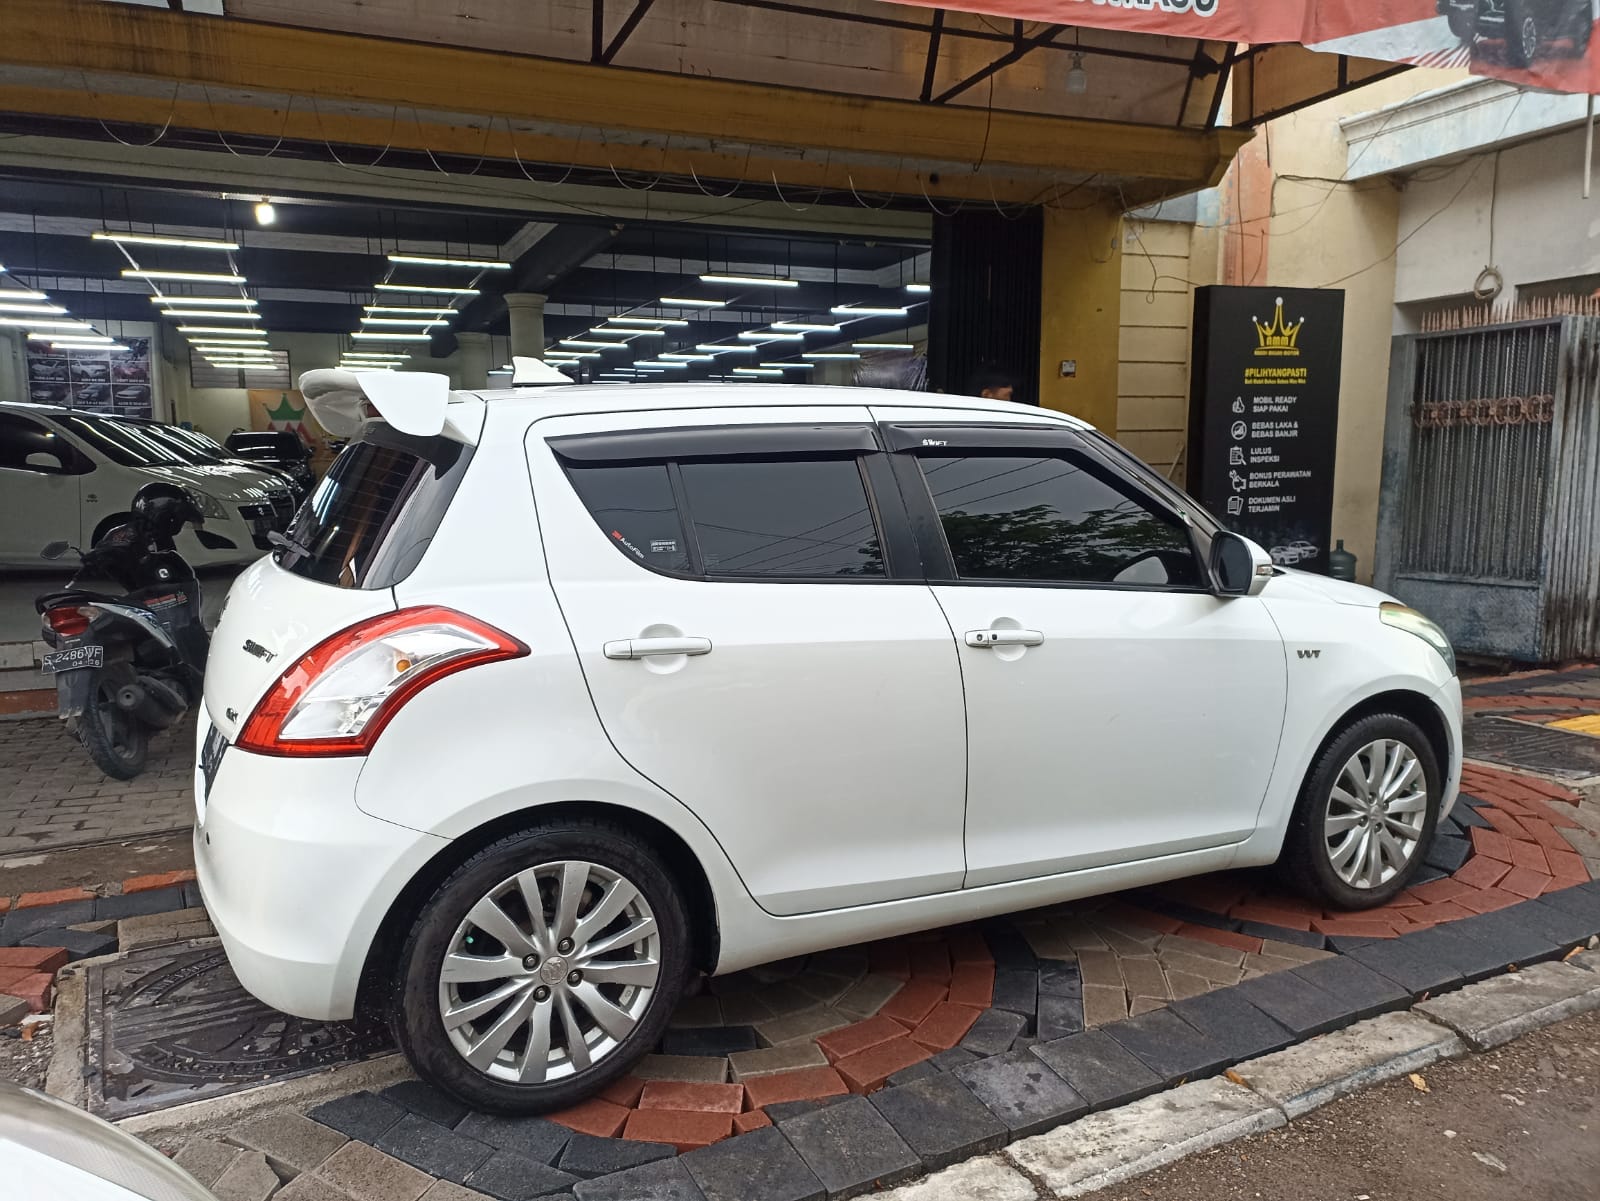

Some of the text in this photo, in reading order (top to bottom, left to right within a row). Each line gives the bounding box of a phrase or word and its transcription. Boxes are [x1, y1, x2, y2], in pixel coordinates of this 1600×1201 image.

[1245, 367, 1307, 377] #PILIHYANGPASTI
[1250, 455, 1280, 463] INSPEKSI
[1273, 470, 1312, 478] PERAWATAN
[1248, 480, 1280, 488] BERKALA
